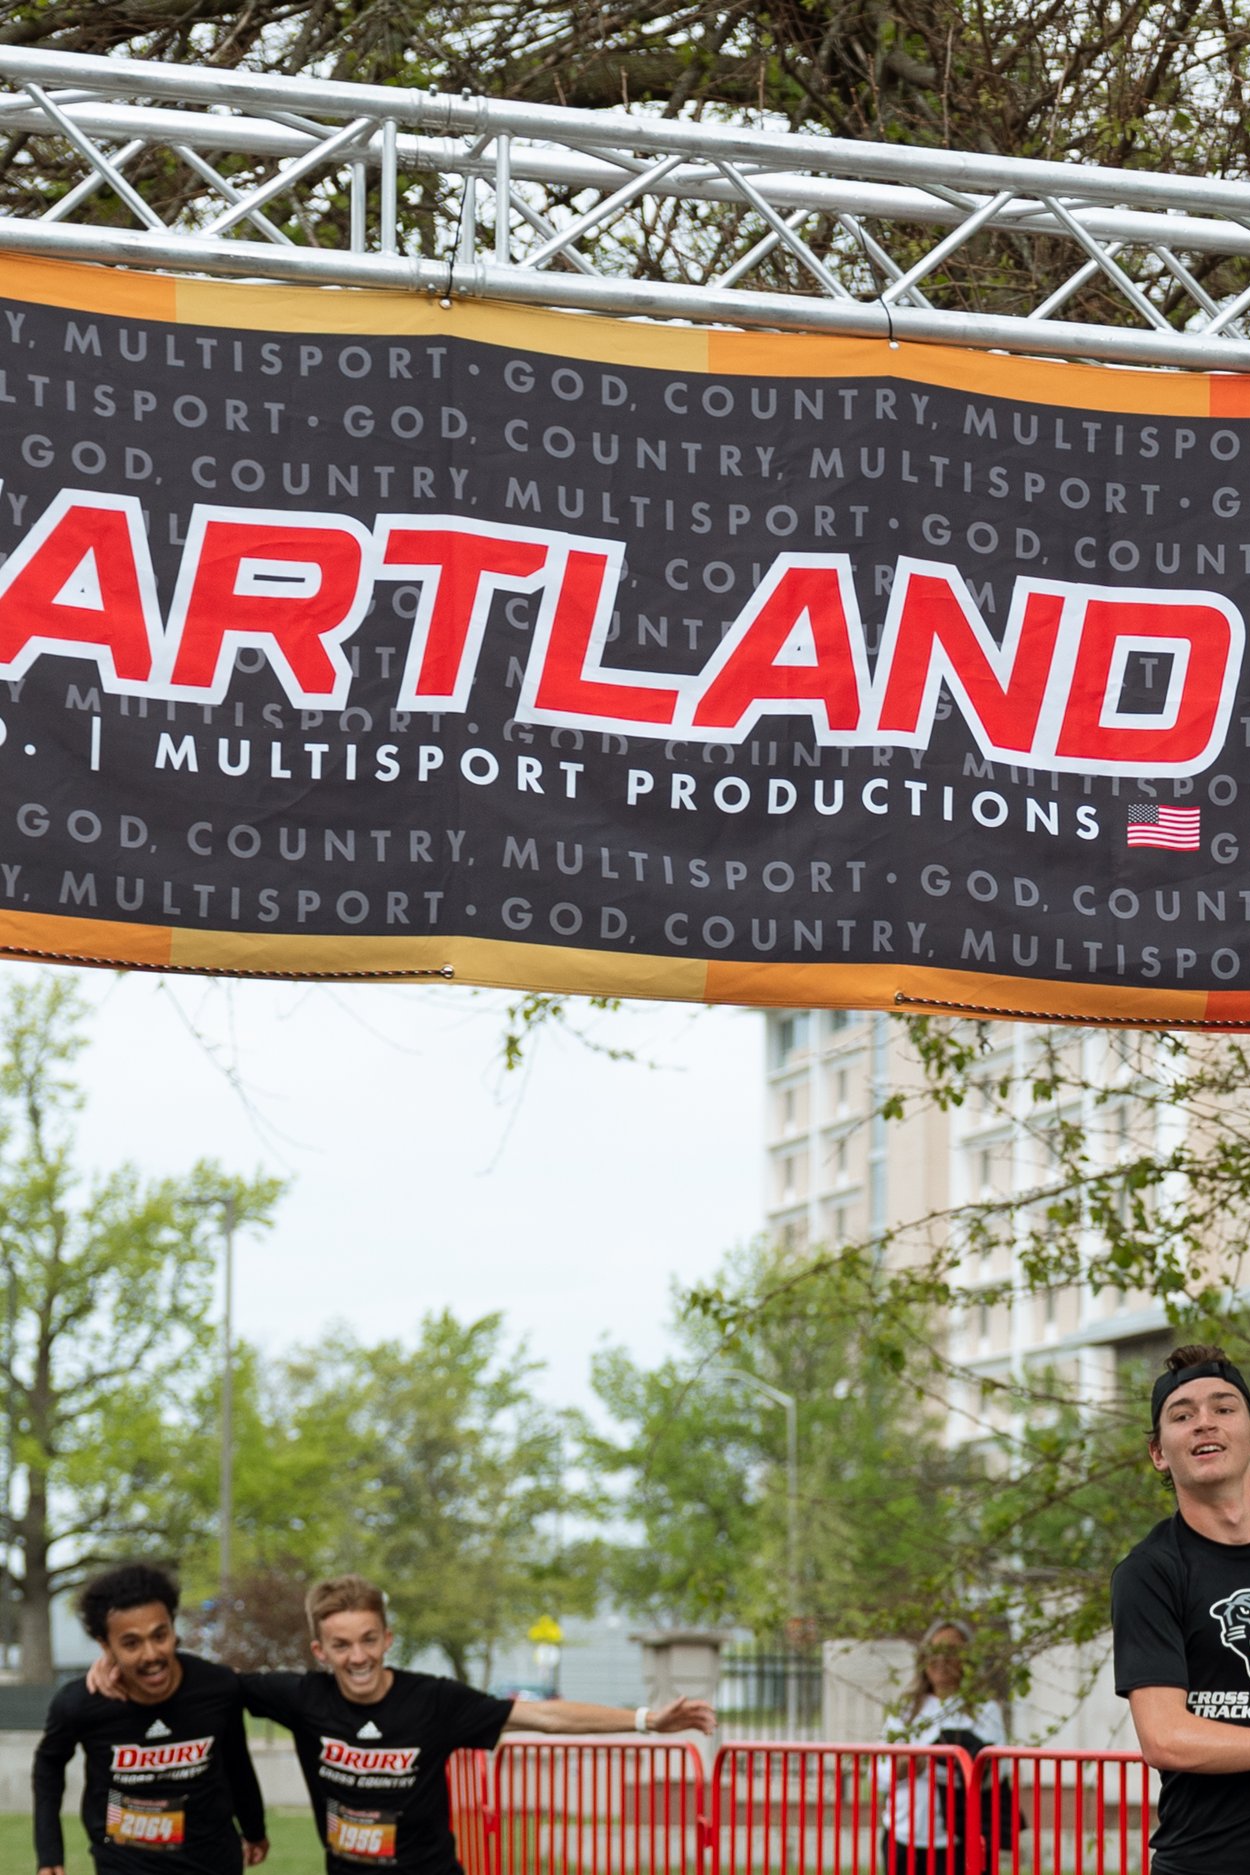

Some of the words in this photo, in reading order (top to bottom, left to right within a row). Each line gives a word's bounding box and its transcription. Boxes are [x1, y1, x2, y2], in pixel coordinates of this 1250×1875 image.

[65, 322, 446, 378] MULTISPORT
[505, 361, 637, 412] GOD,
[665, 382, 938, 430] COUNTRY,
[22, 435, 162, 485] GOD,
[192, 456, 478, 505] COUNTRY,
[506, 477, 870, 536] MULTISPORT
[923, 514, 1050, 565] GOD,
[344, 405, 477, 444] GOD,
[505, 419, 784, 483] COUNTRY,
[810, 448, 1159, 514] MULTISPORT
[155, 732, 584, 798] MULTISPORT
[627, 768, 1100, 840] PRODUCTIONS
[17, 804, 157, 854] GOD,
[188, 822, 475, 867] COUNTRY,
[503, 836, 865, 892] MULTISPORT
[921, 865, 1049, 912] GOD,
[60, 871, 443, 923] MULTISPORT
[502, 898, 636, 944] GOD,
[665, 913, 935, 959] COUNTRY,
[1187, 1690, 1250, 1706] CROSS
[114, 1739, 213, 1770] DRURY
[321, 1740, 418, 1772] DRURY
